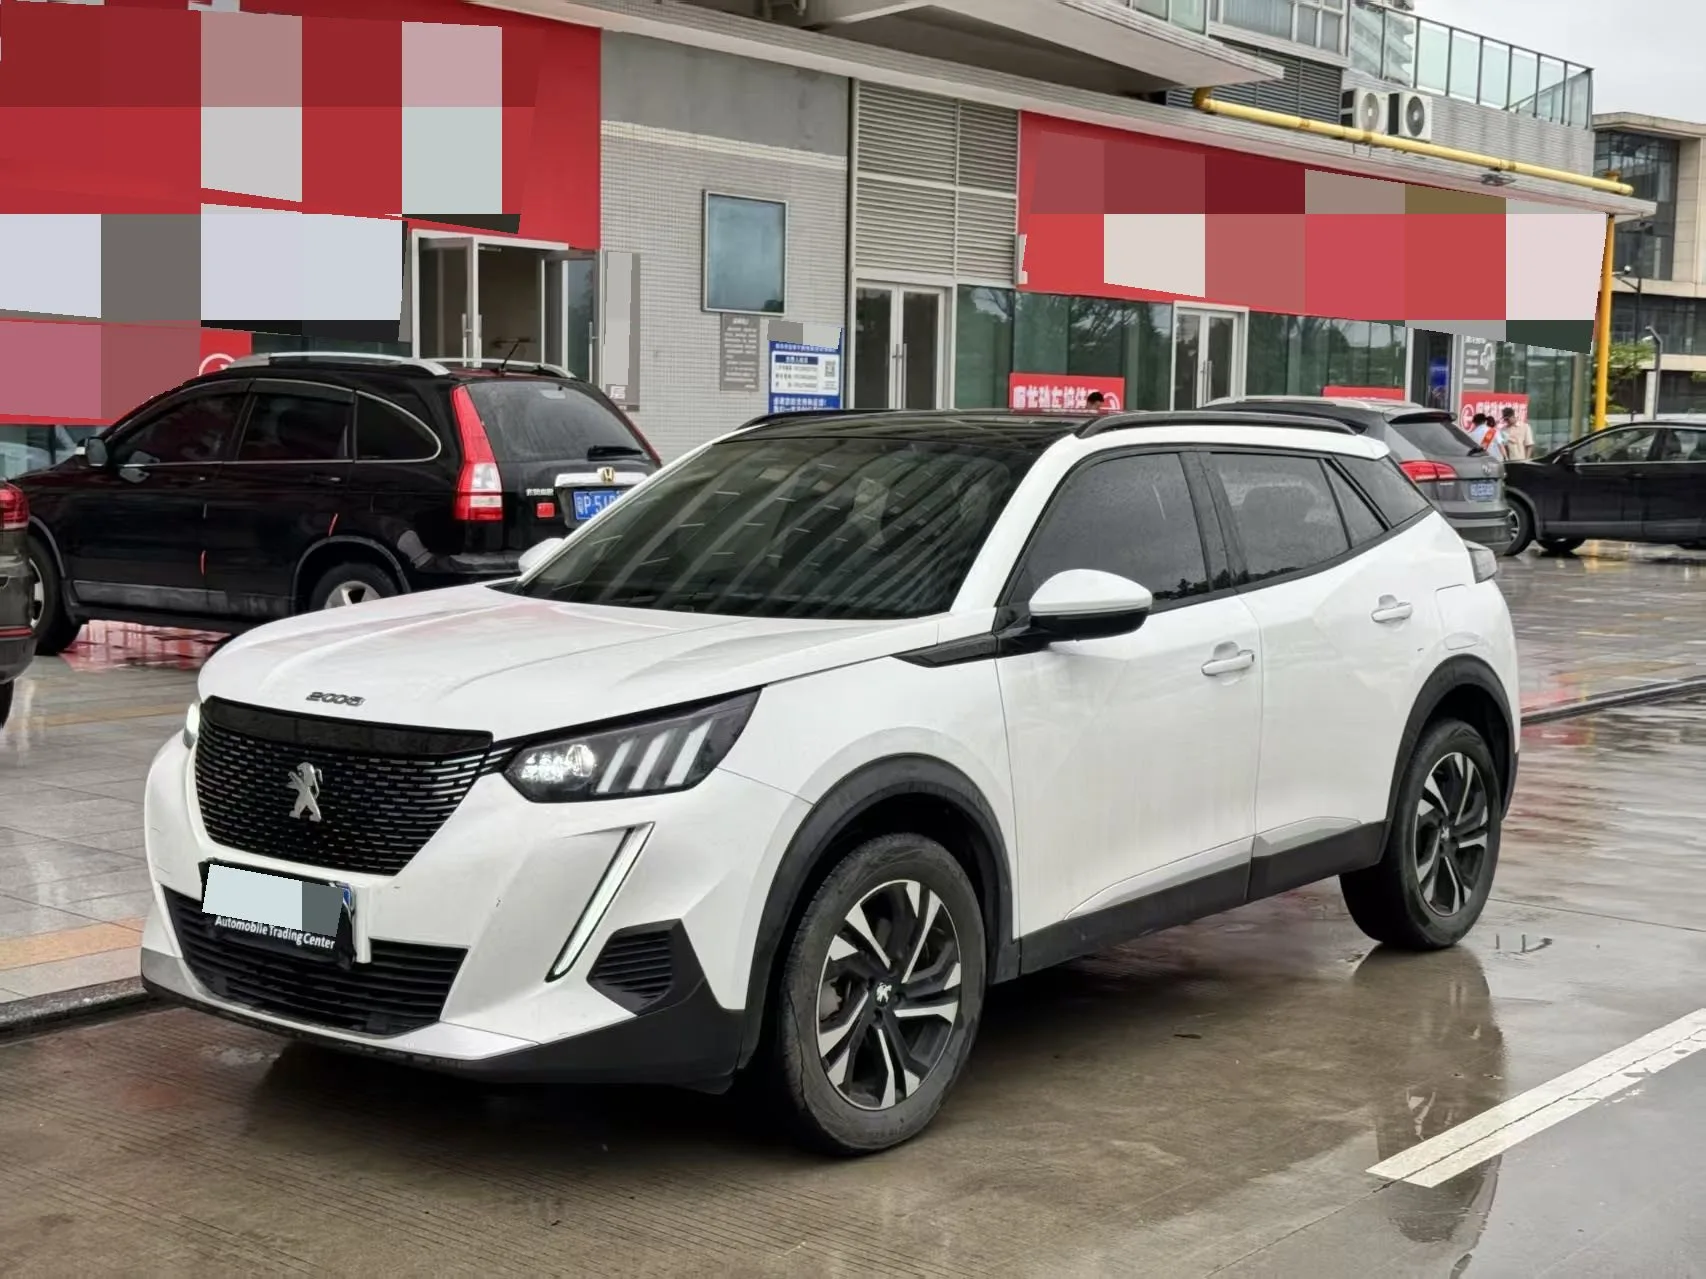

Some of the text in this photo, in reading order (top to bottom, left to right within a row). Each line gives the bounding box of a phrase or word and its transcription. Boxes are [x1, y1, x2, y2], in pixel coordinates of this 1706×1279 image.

[305, 691, 366, 707] 2008
[214, 915, 336, 950] Automobile Trading Center
